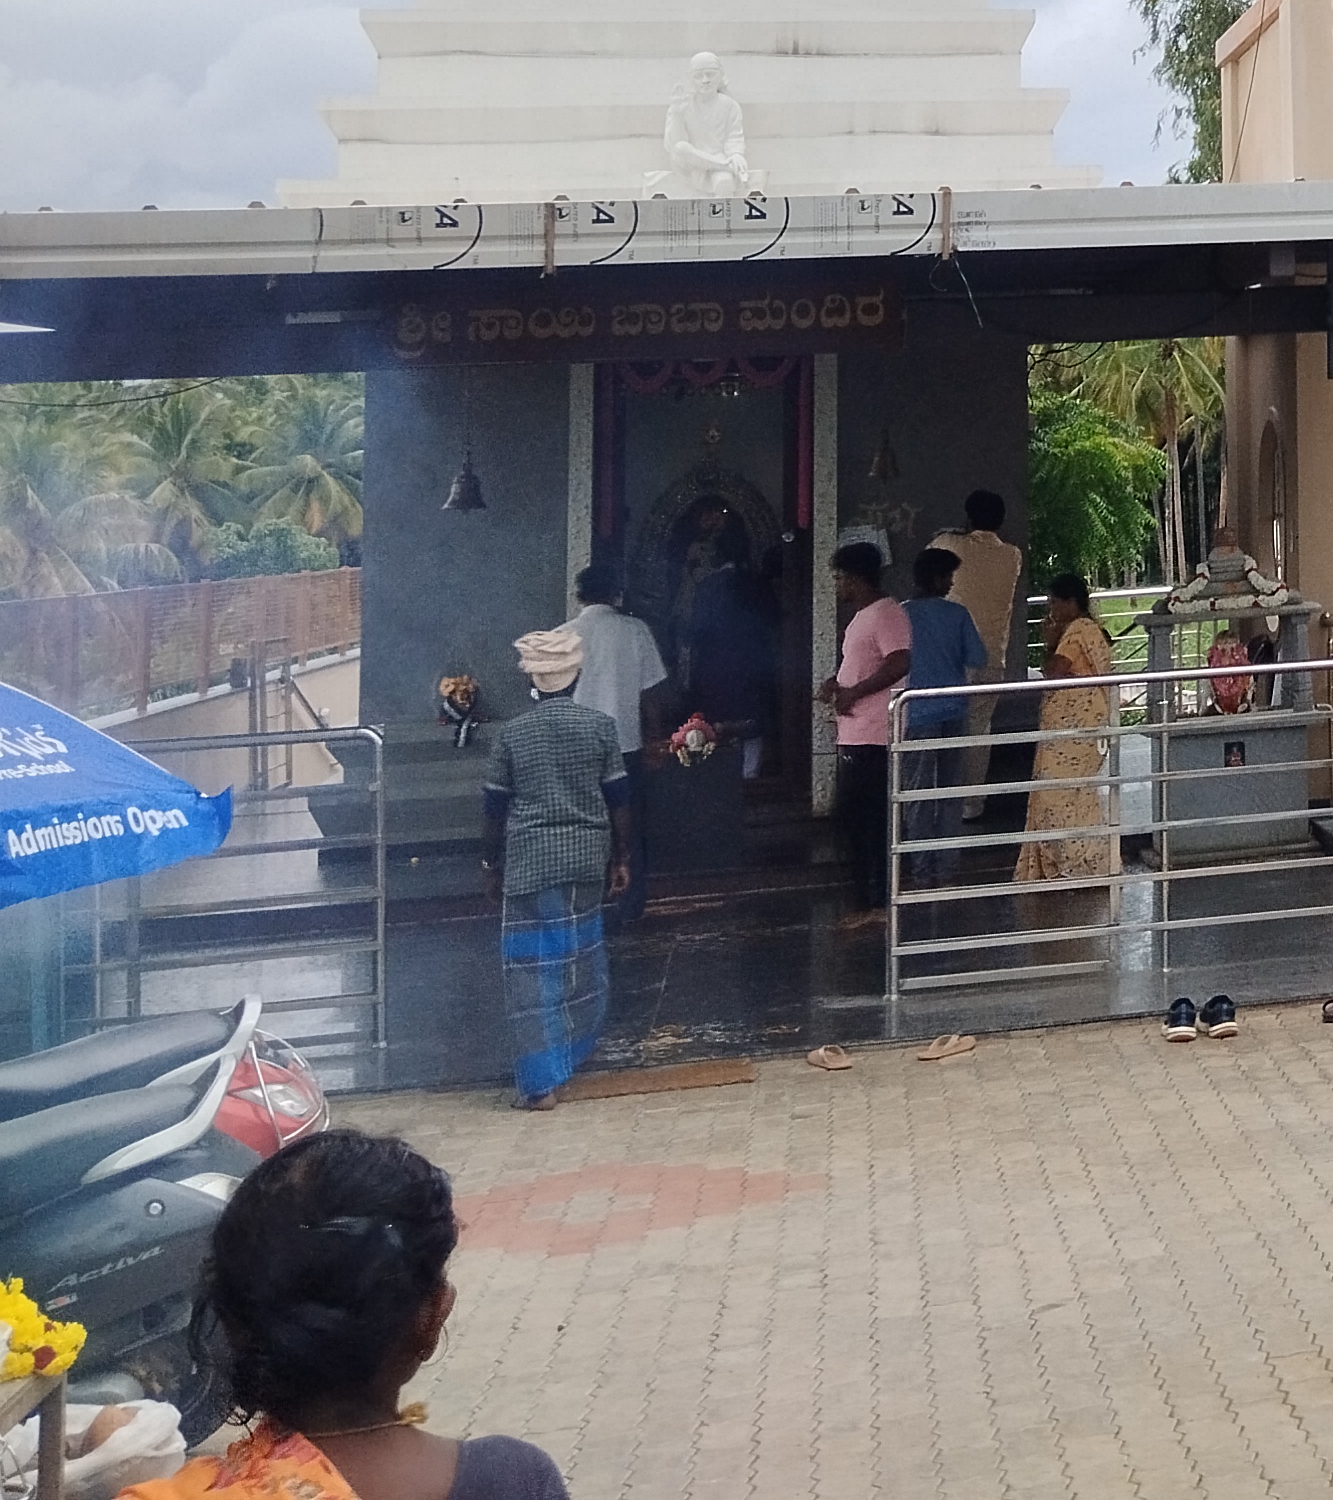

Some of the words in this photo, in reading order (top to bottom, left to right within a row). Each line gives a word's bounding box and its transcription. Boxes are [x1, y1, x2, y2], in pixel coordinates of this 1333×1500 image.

[393, 300, 453, 360] ಶ್ರೀ
[466, 306, 597, 342] ಸಾಯಿ
[611, 302, 725, 336] ಬಾಬಾ
[738, 288, 886, 330] ಮಂದಿರ
[7, 811, 125, 859] Admissions
[126, 806, 190, 837] Open
[47, 1246, 165, 1294] Activa
